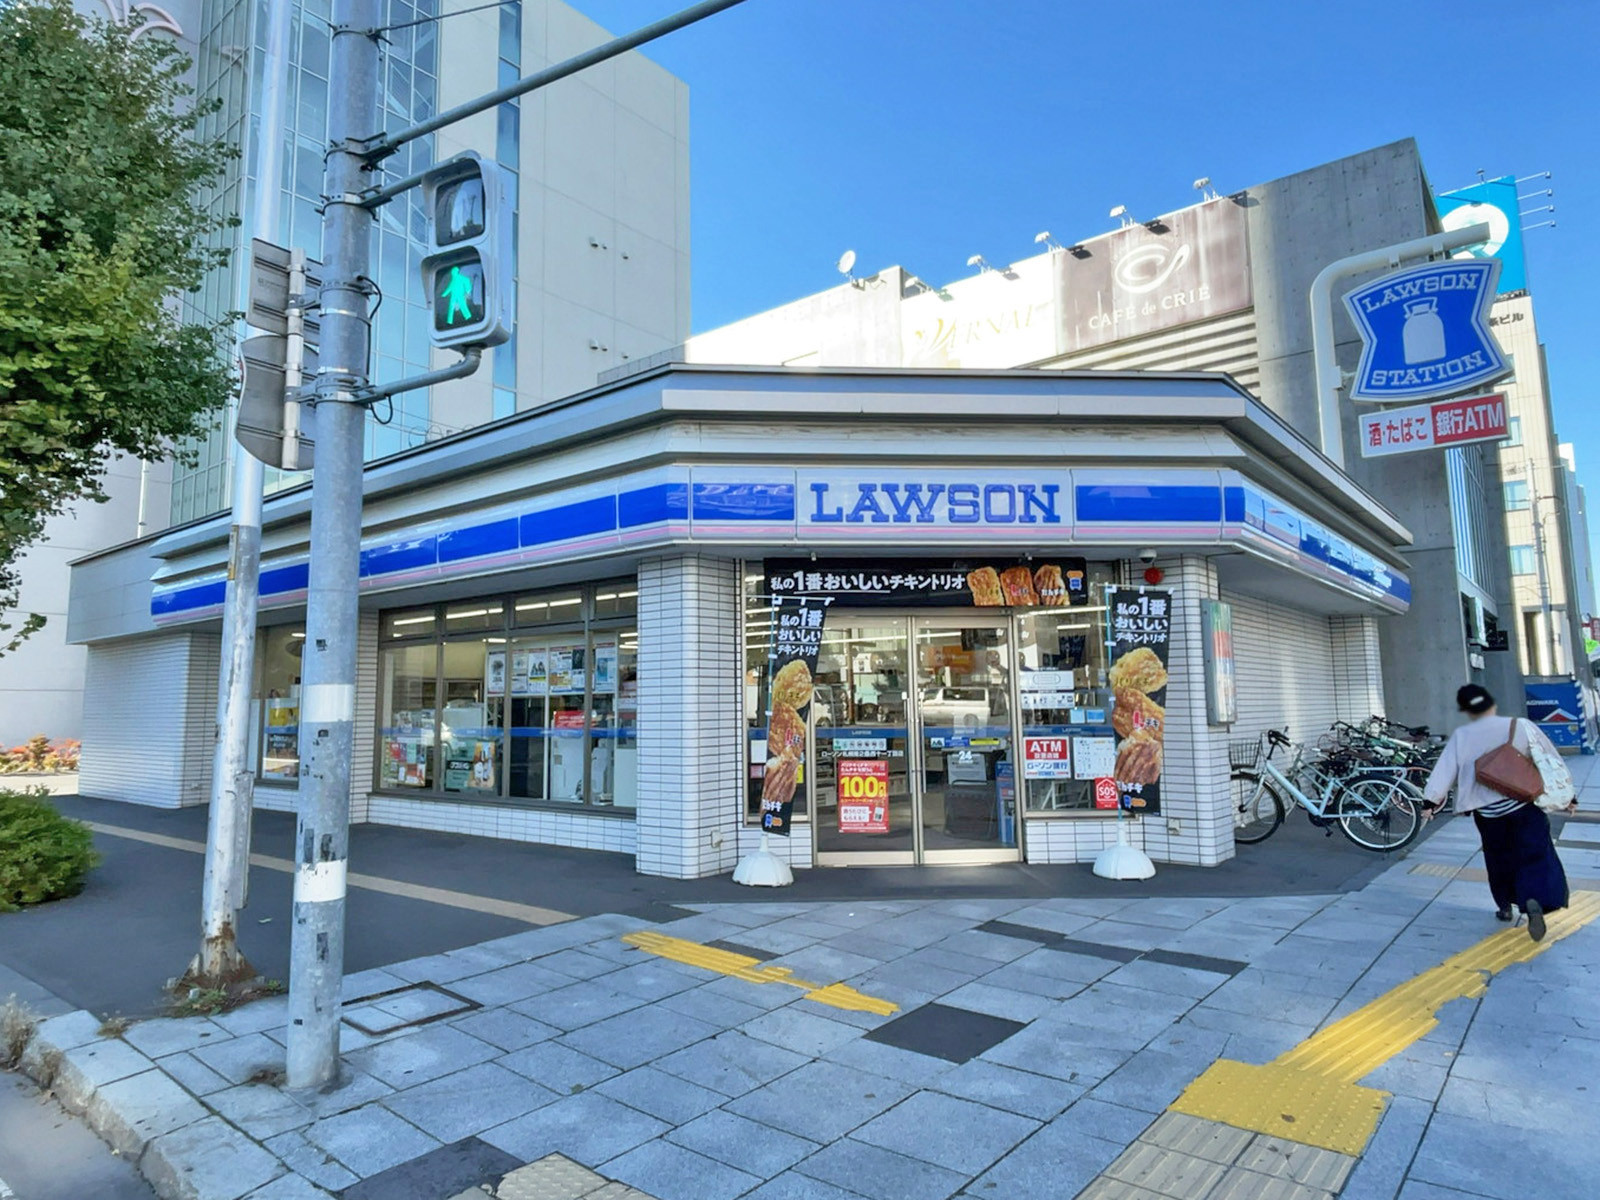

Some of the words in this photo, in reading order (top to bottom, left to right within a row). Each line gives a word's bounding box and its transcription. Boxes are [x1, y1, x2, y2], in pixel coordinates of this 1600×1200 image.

[1361, 272, 1480, 313] LAWSON
[1141, 301, 1157, 316] de
[1370, 350, 1487, 387] STATION
[1368, 416, 1428, 447] 酒・たばこ
[1435, 402, 1505, 438] 銀行ATM
[810, 483, 1061, 523] LAWSON
[770, 570, 966, 591] 私の1番おいしいチキントリオ
[1116, 596, 1167, 615] 私の1番
[780, 607, 823, 627] 私の1番
[1115, 616, 1168, 631] おいしい
[778, 628, 821, 642] おいしい
[1115, 632, 1167, 644] チキントリオ
[777, 645, 819, 656] チキントリオ
[1030, 740, 1062, 752] ATM
[958, 750, 973, 760] 24
[1026, 762, 1068, 770] ローソン銀行
[1098, 786, 1115, 796] SOS
